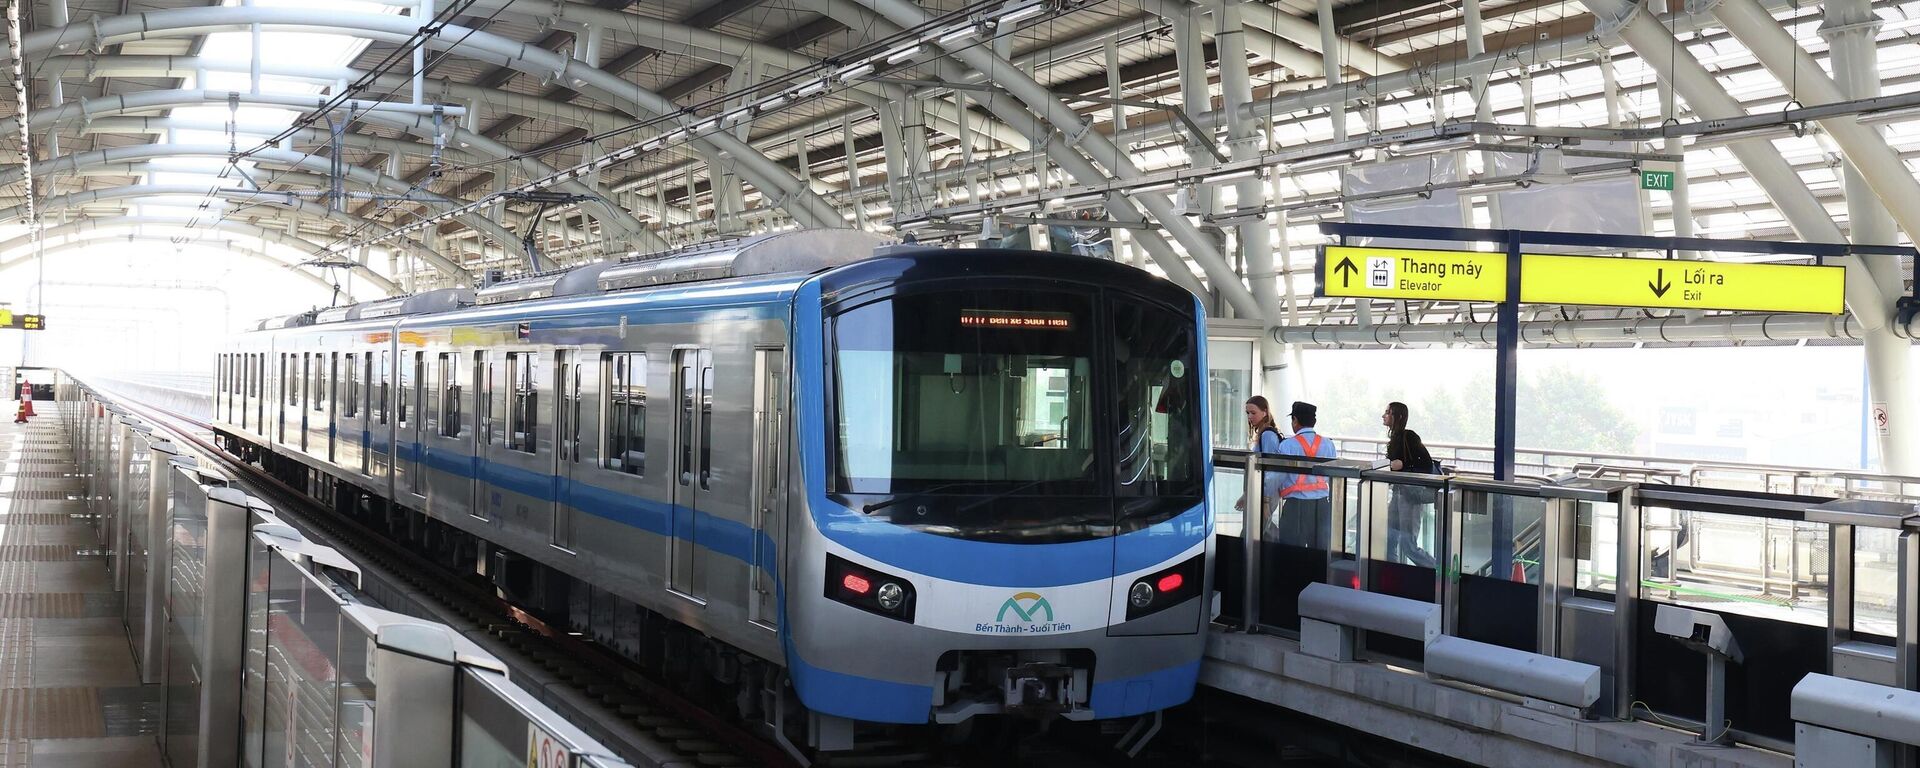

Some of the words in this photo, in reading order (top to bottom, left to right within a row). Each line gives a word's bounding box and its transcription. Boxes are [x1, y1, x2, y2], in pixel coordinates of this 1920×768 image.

[1646, 173, 1669, 187] EXIT
[1401, 257, 1446, 278] Thang
[1451, 260, 1483, 279] máy
[1684, 267, 1705, 284] Lối
[1709, 274, 1724, 285] ra
[1400, 279, 1442, 291] Elevator
[1684, 289, 1702, 301] Exit
[975, 622, 993, 632] Bến
[995, 624, 1023, 633] Thành
[1052, 622, 1071, 632] Tiên
